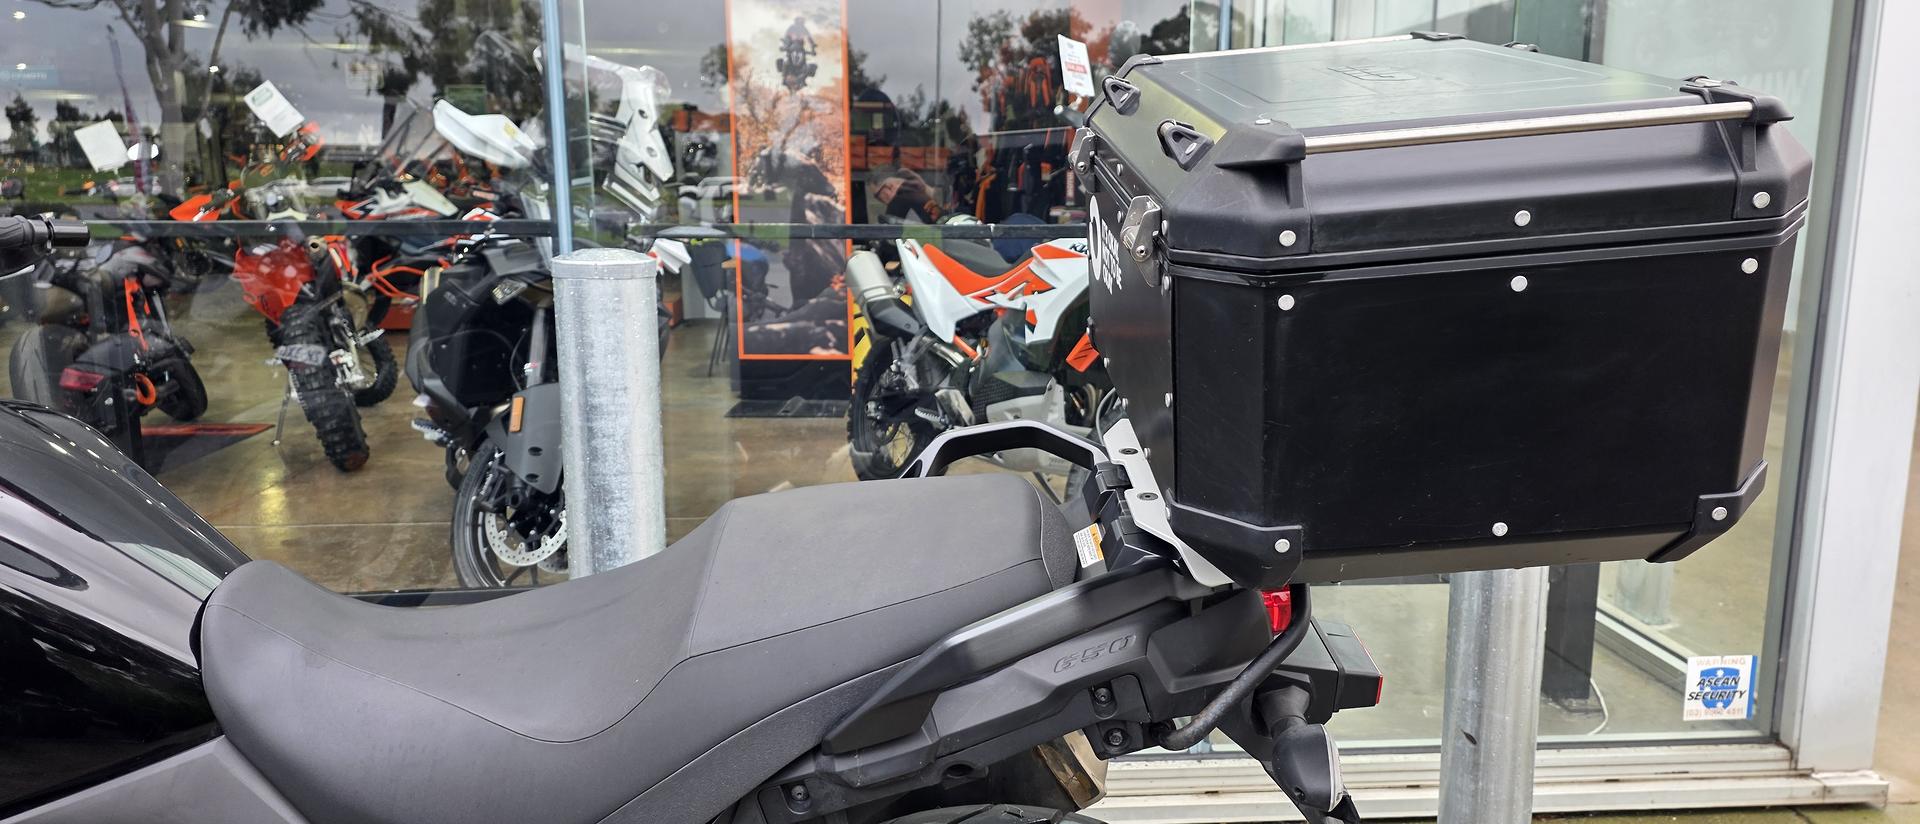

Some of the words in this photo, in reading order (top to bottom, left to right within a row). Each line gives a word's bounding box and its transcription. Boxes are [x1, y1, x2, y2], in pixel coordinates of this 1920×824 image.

[1054, 634, 1136, 674] 650
[1696, 676, 1740, 687] ASCAN
[1687, 689, 1747, 701] SECURITY
